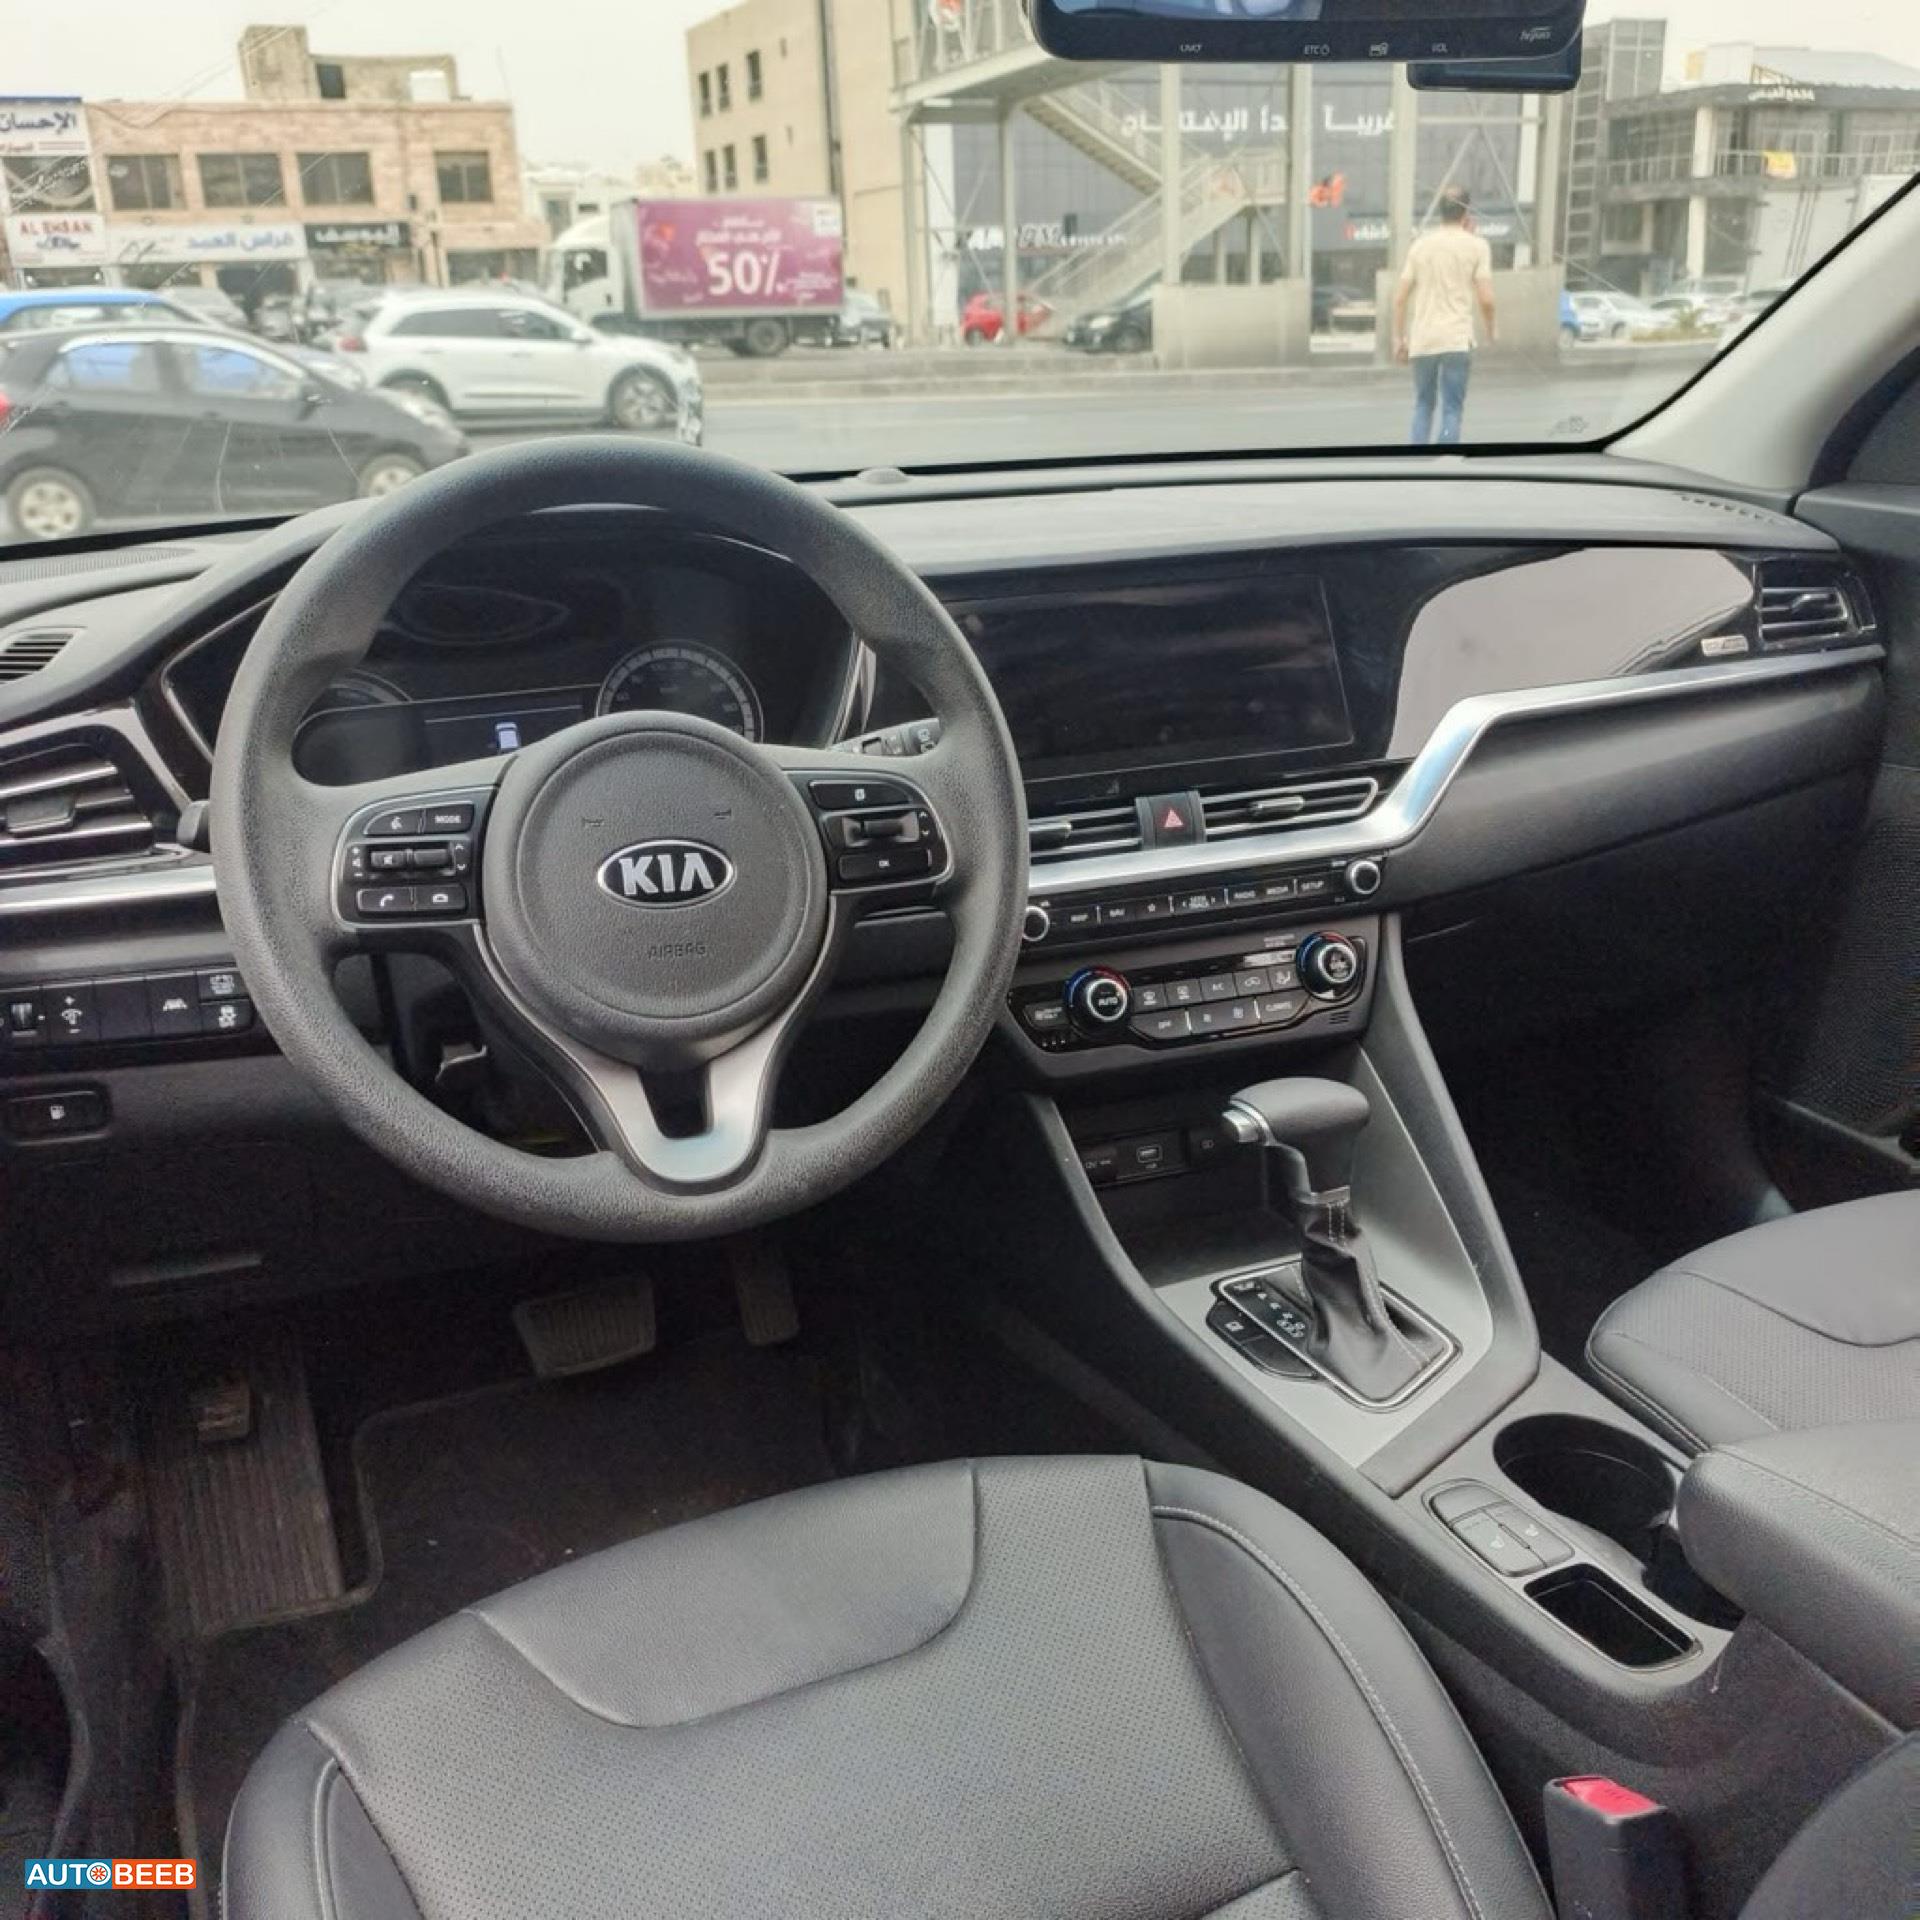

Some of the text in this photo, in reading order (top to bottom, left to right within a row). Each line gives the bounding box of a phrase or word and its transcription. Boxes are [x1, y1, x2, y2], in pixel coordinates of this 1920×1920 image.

[707, 250, 786, 296] 50%
[434, 815, 462, 824] MODE
[618, 852, 715, 895] KIA
[648, 943, 707, 960] AIRBAG
[1098, 996, 1118, 1006] AUTO
